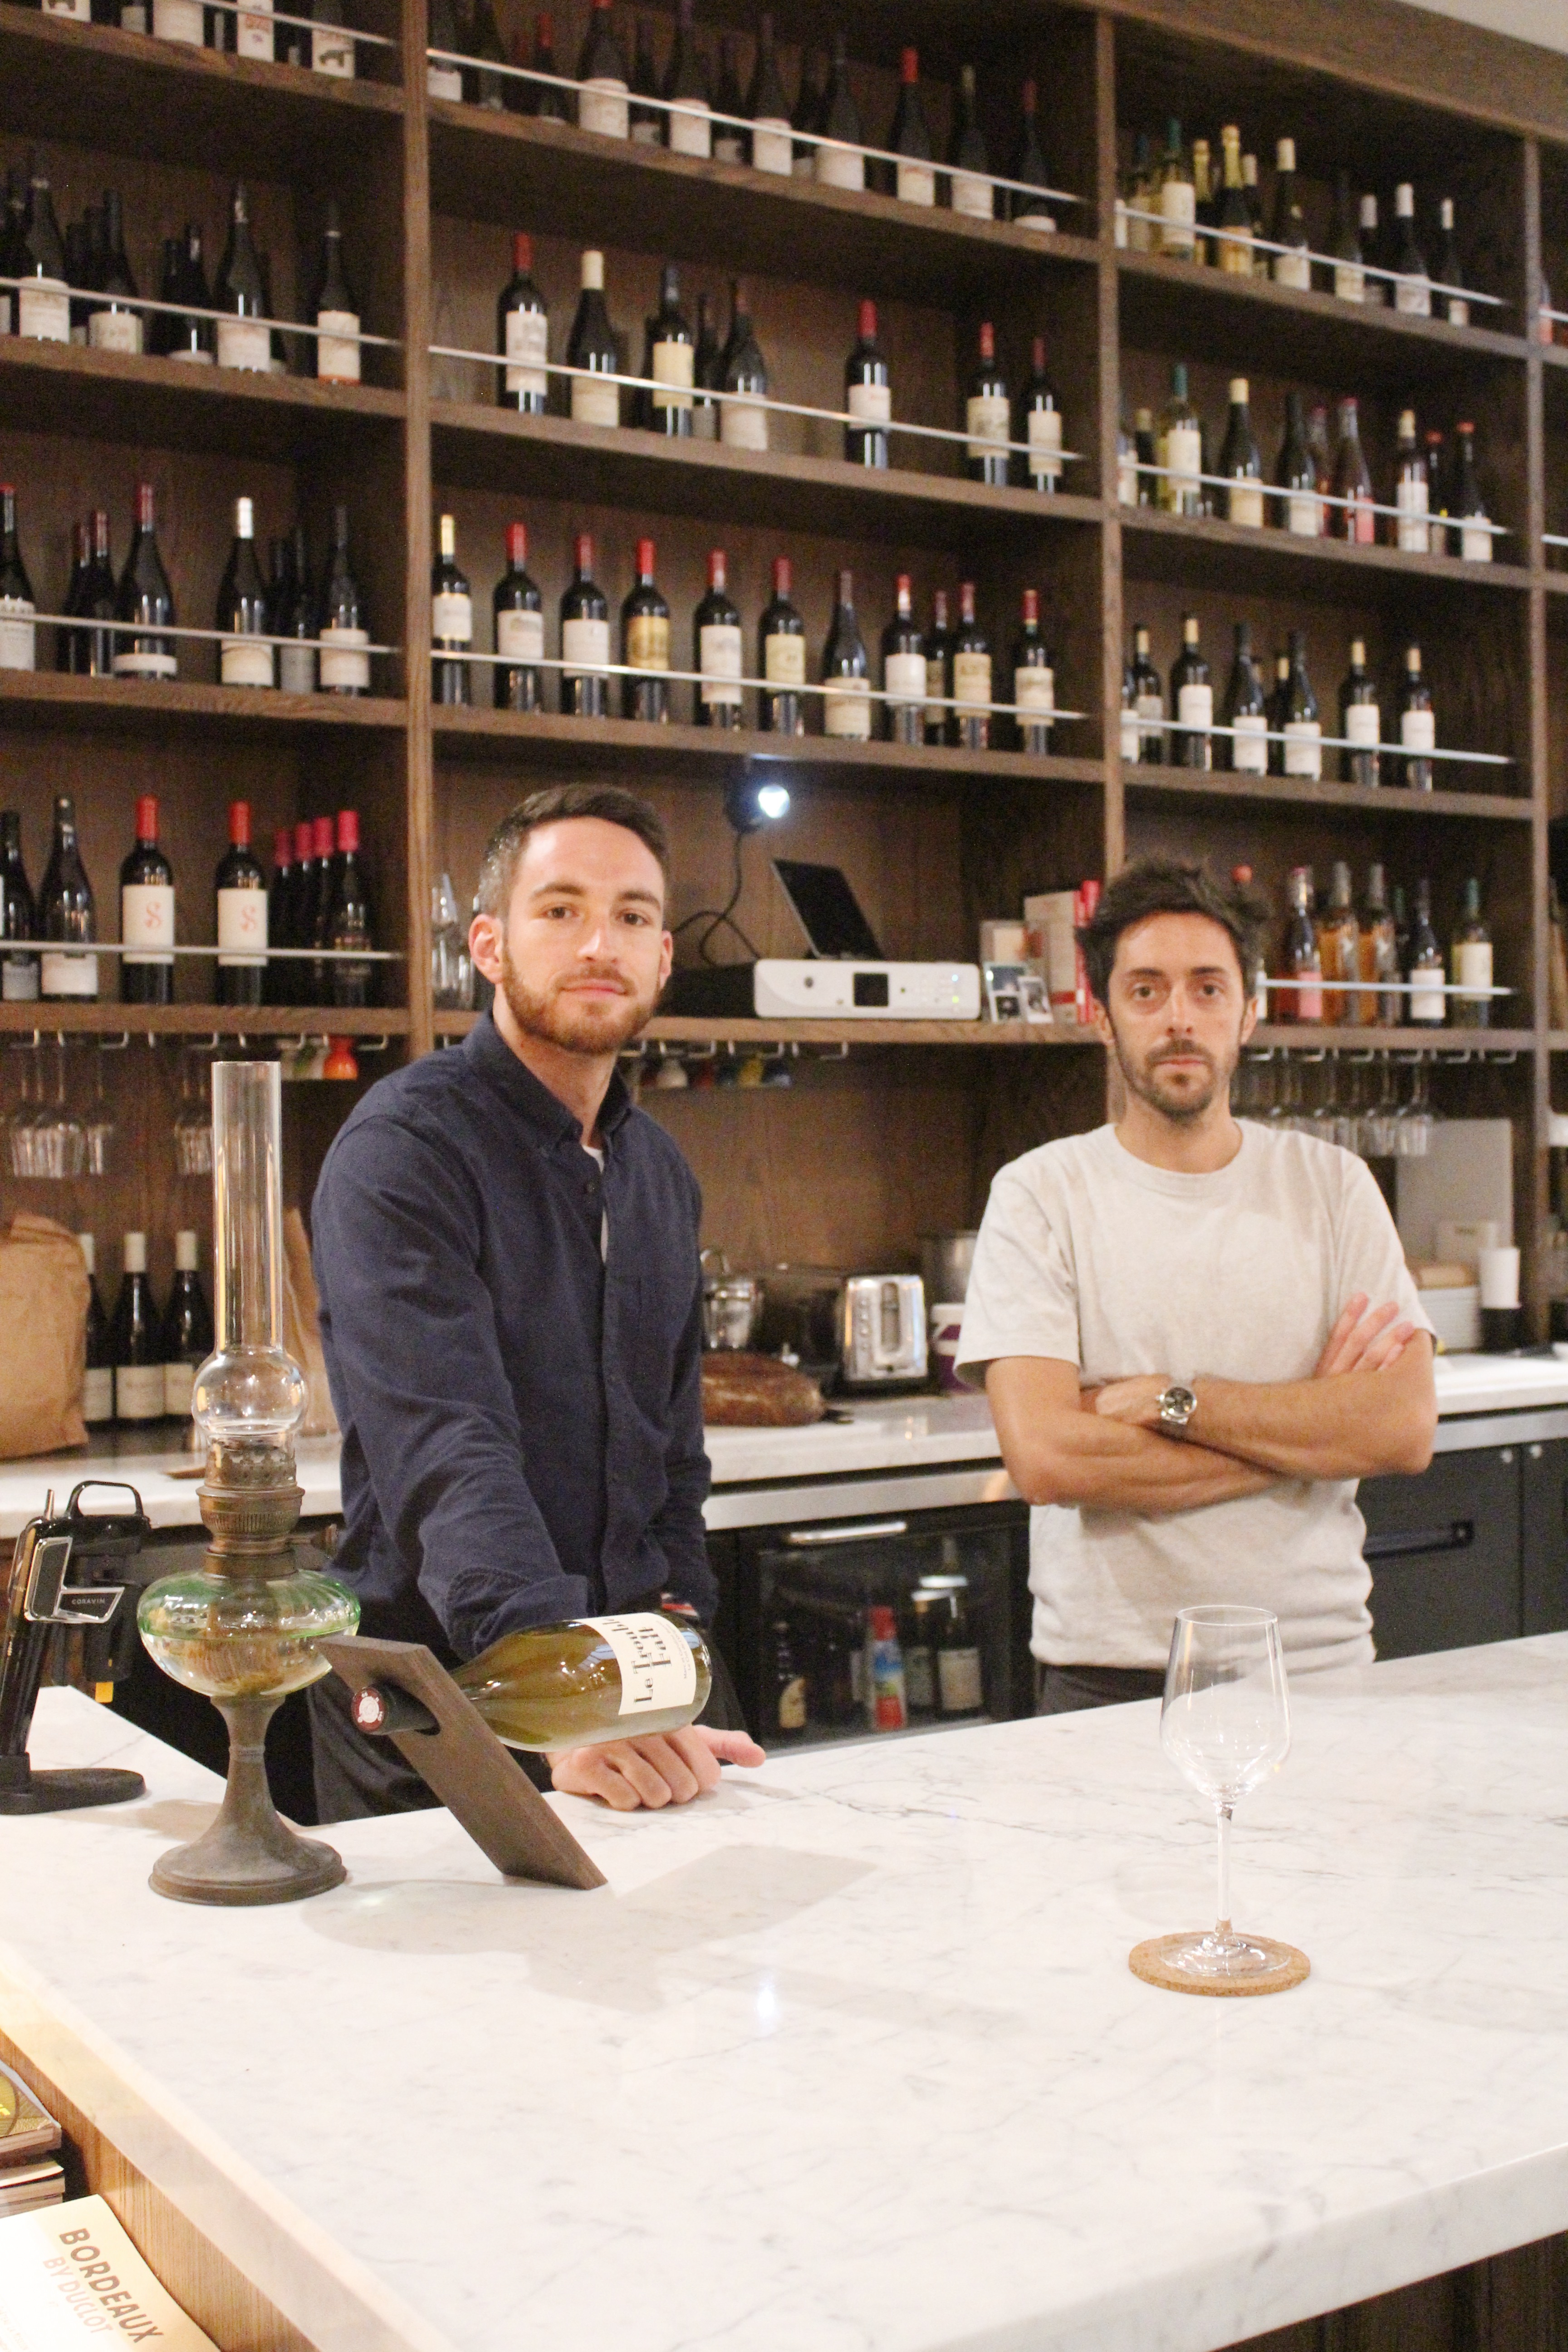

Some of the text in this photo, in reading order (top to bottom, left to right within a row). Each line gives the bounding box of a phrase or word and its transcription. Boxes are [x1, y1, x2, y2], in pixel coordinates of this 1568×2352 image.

[602, 1618, 653, 1704] Le Trouble
[637, 1627, 672, 1670] Fait
[43, 2256, 114, 2333] BY DUCLOT
[58, 2228, 164, 2343] BORDEAUX
